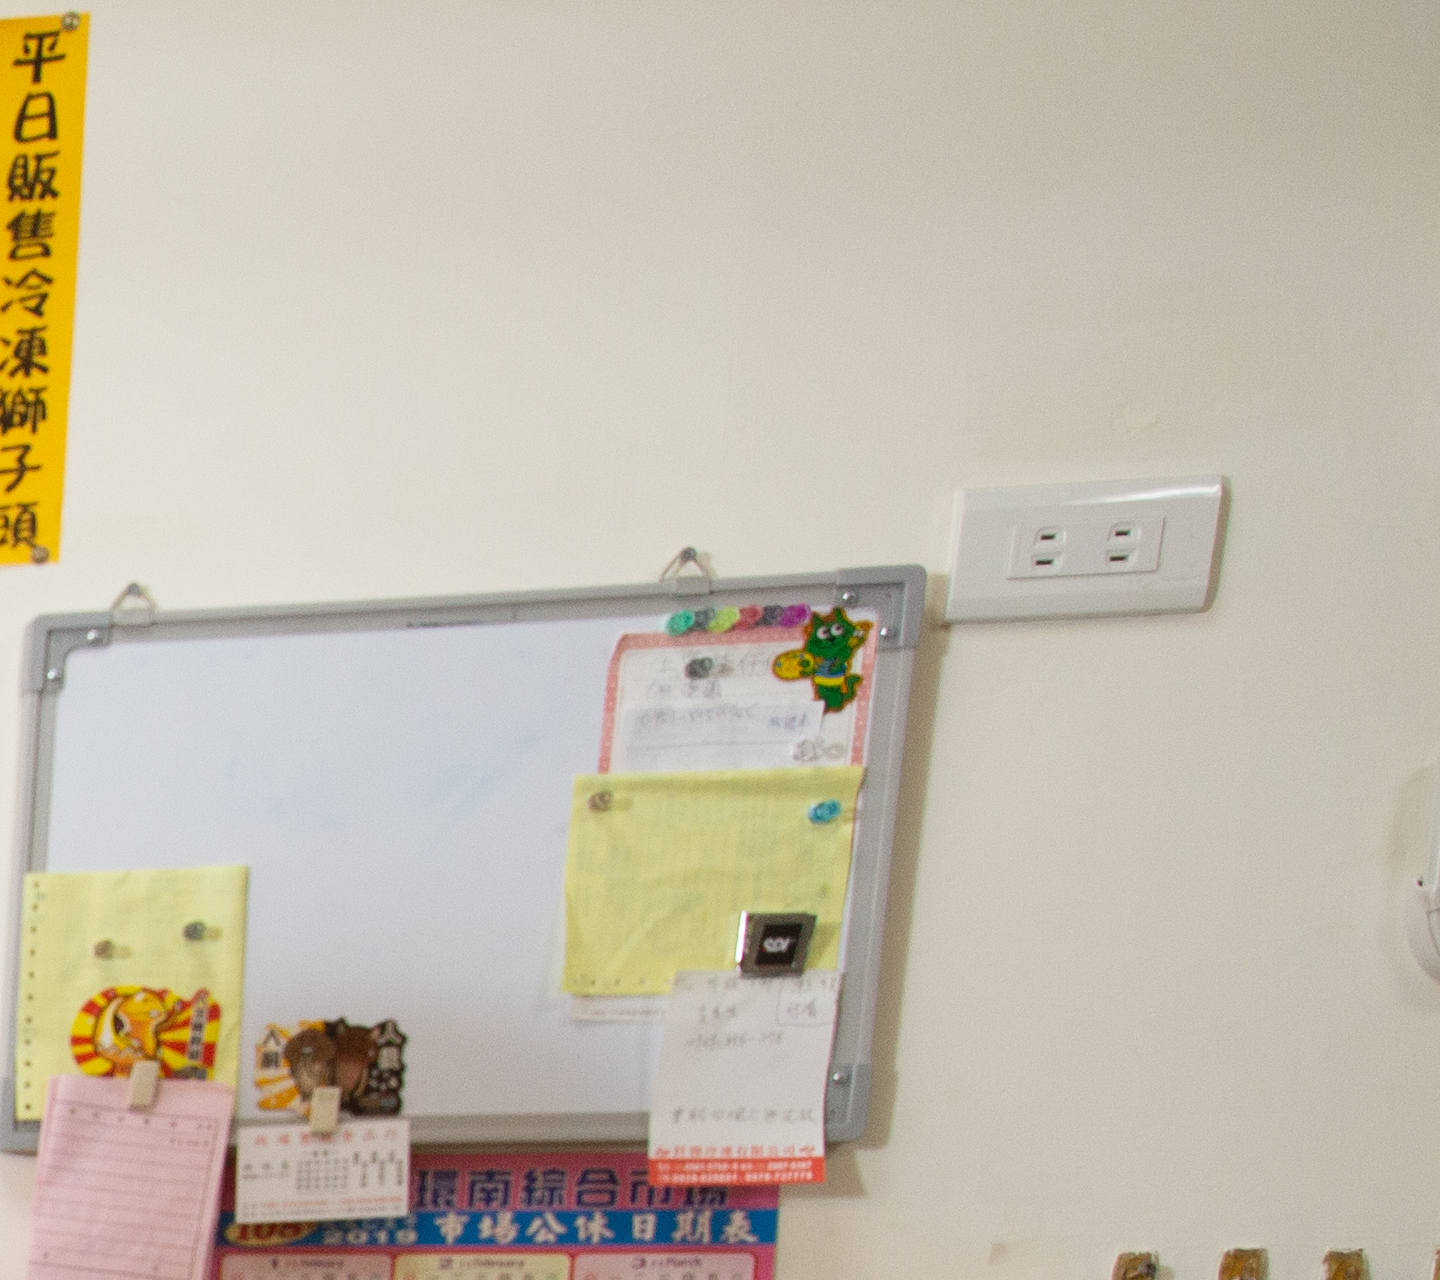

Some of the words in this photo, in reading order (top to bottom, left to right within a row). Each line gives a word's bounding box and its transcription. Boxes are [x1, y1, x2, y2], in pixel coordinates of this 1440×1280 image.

[433, 1210, 760, 1246] 市場公休日期表
